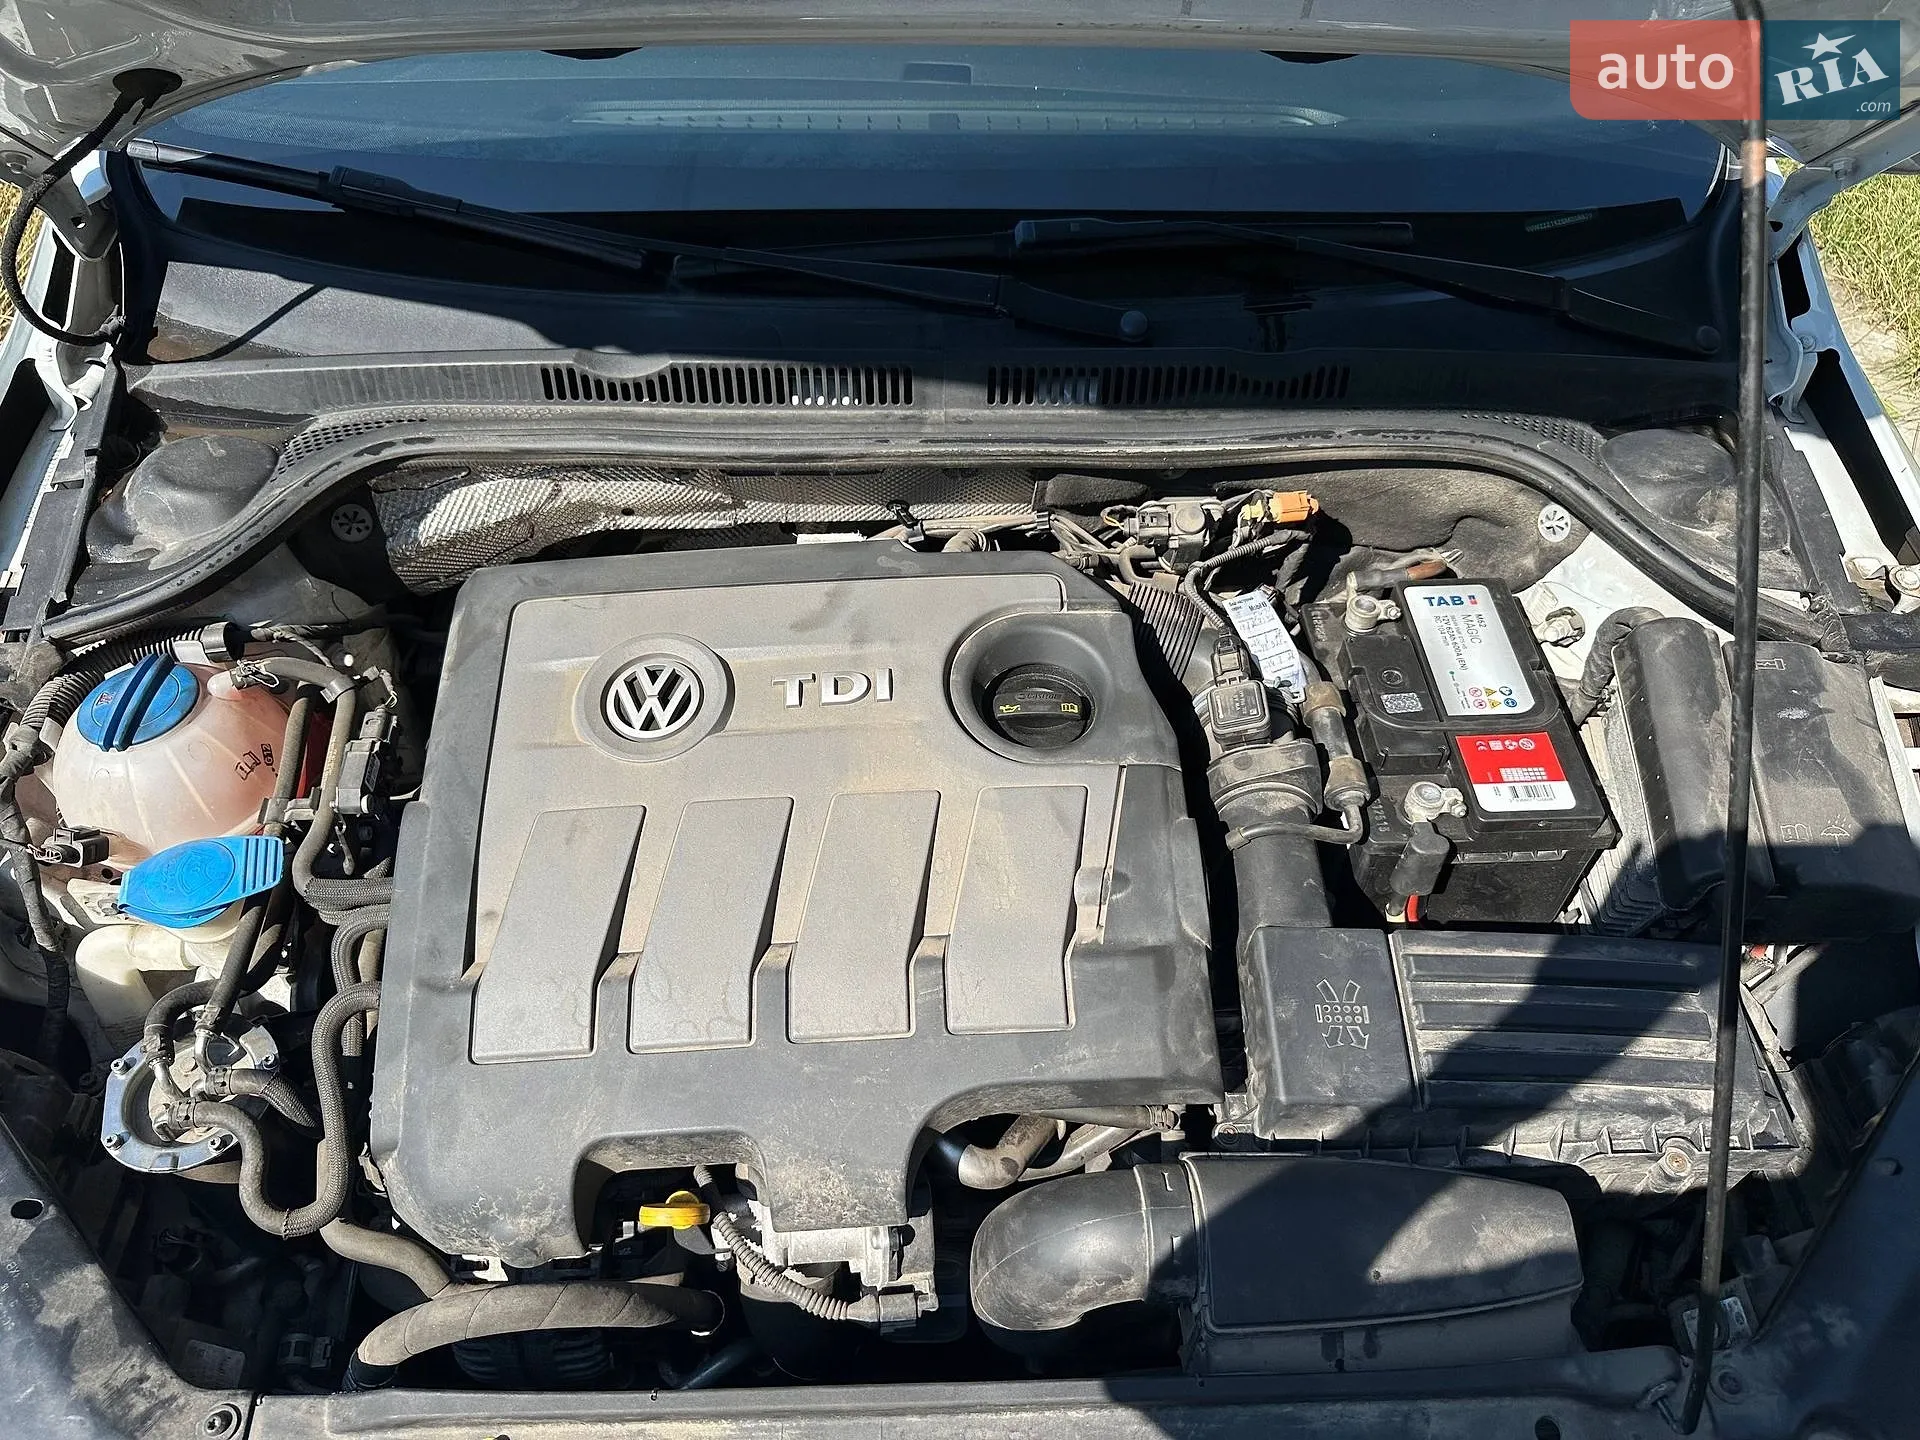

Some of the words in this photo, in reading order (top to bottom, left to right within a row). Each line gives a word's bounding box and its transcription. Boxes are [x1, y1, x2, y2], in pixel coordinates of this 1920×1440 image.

[1423, 595, 1465, 607] TAB
[1461, 614, 1482, 644] MAGIC
[772, 667, 894, 709] TDI
[262, 743, 273, 765] G12
